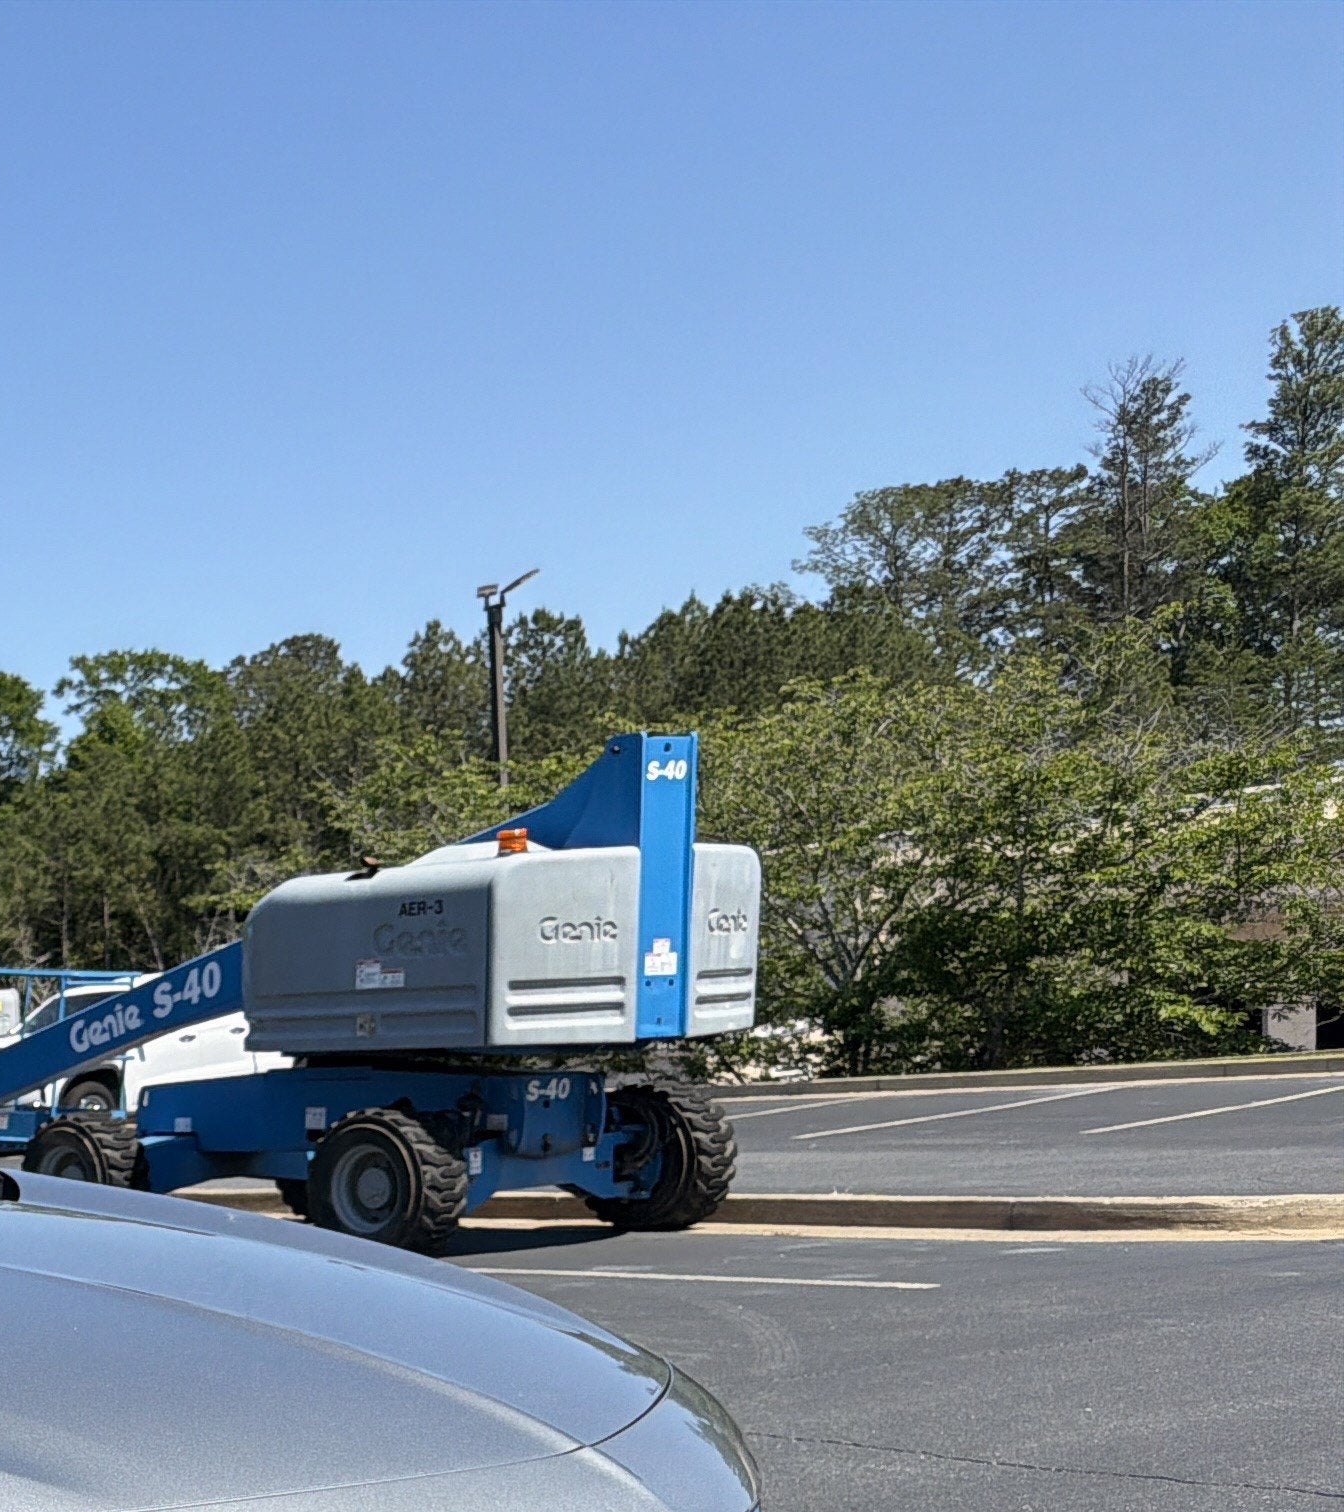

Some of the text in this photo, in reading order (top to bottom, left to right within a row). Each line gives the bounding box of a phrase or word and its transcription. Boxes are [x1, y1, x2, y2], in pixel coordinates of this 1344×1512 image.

[646, 759, 688, 781] S-40
[538, 915, 619, 944] Genie
[69, 960, 222, 1053] Genie S-40
[525, 1077, 571, 1102] S-40
